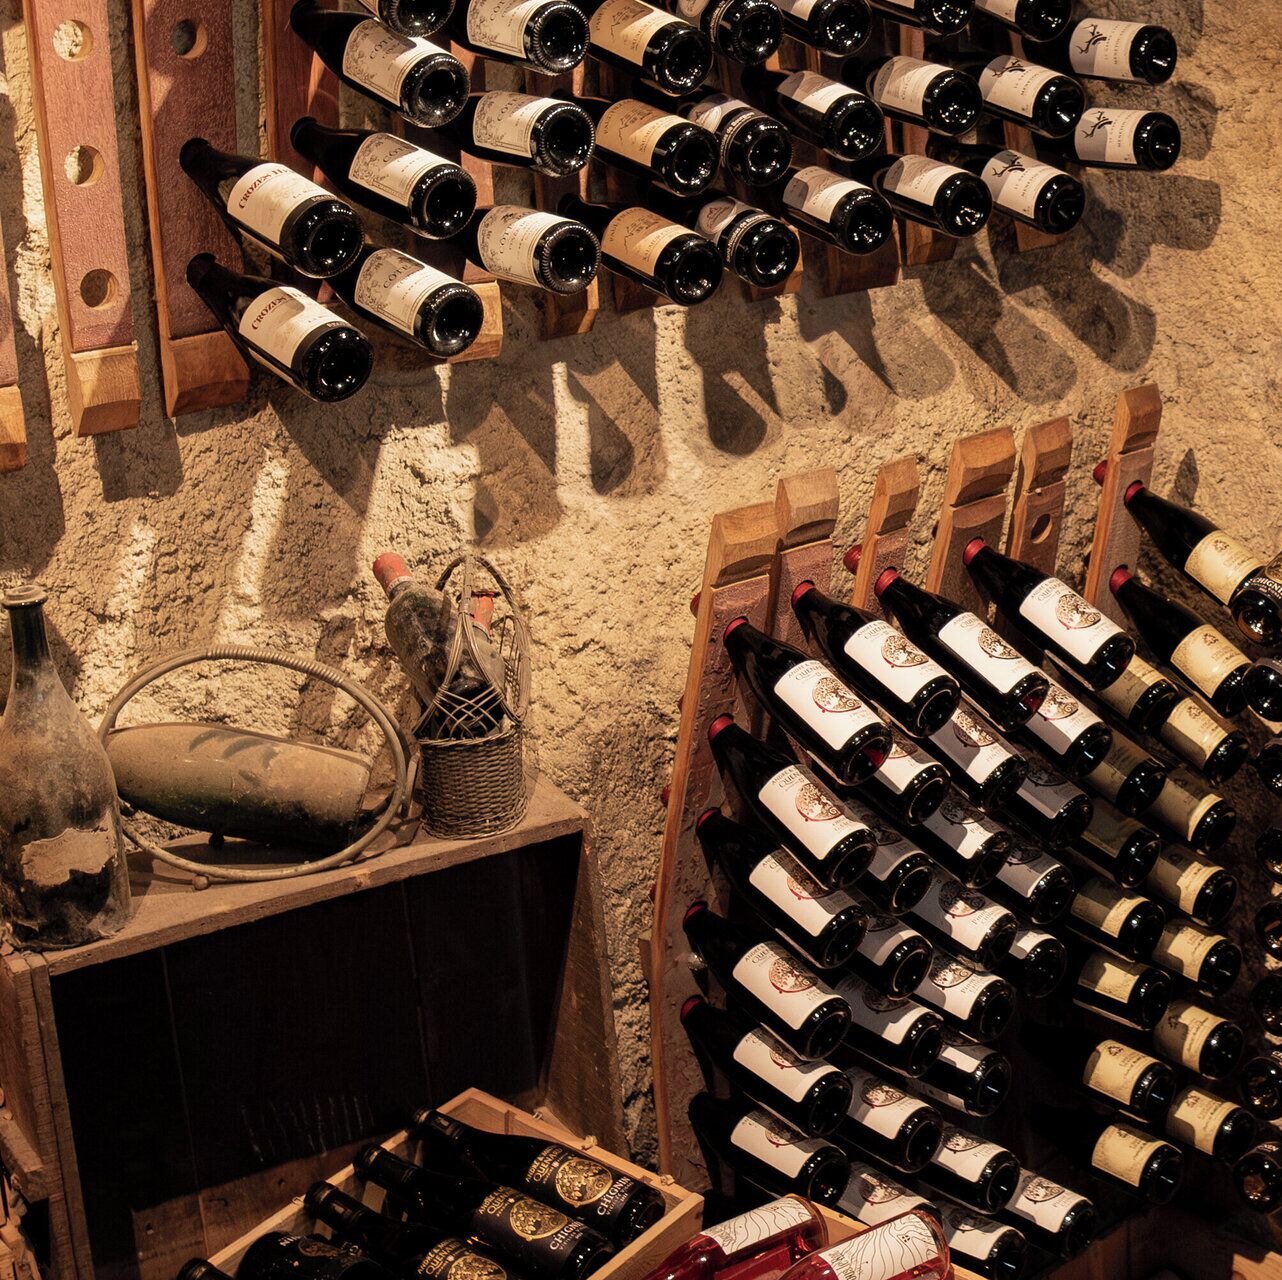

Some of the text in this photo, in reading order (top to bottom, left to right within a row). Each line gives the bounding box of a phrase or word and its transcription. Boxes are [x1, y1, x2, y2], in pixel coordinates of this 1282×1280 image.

[238, 171, 272, 210] CROZES
[248, 293, 288, 331] CROZES
[595, 1176, 631, 1217] CHIGNIN
[424, 1237, 461, 1276] QUENARD
